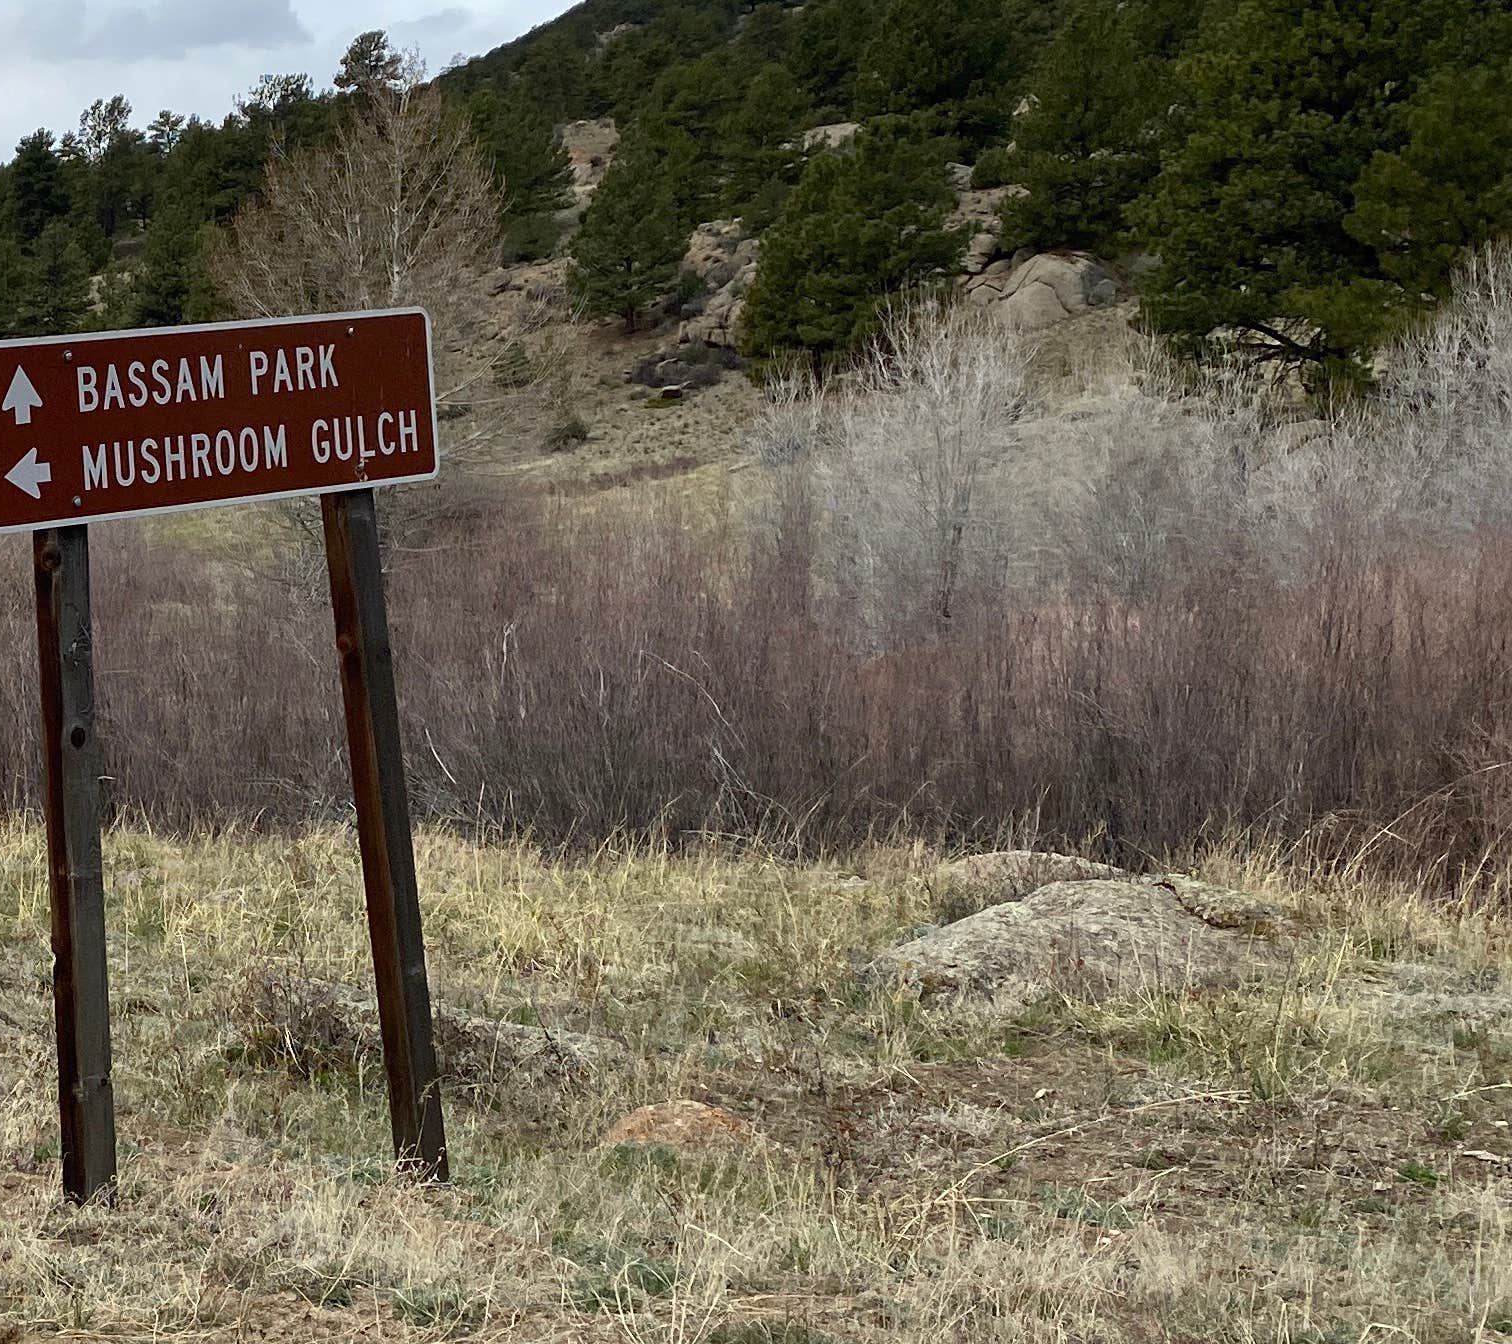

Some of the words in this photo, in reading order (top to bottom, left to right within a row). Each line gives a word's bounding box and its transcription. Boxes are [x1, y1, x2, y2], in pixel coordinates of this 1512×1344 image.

[76, 354, 226, 413] BASSAM
[249, 343, 340, 395] PARK
[82, 424, 289, 491] MUSHROOM
[311, 409, 419, 464] GULCH
